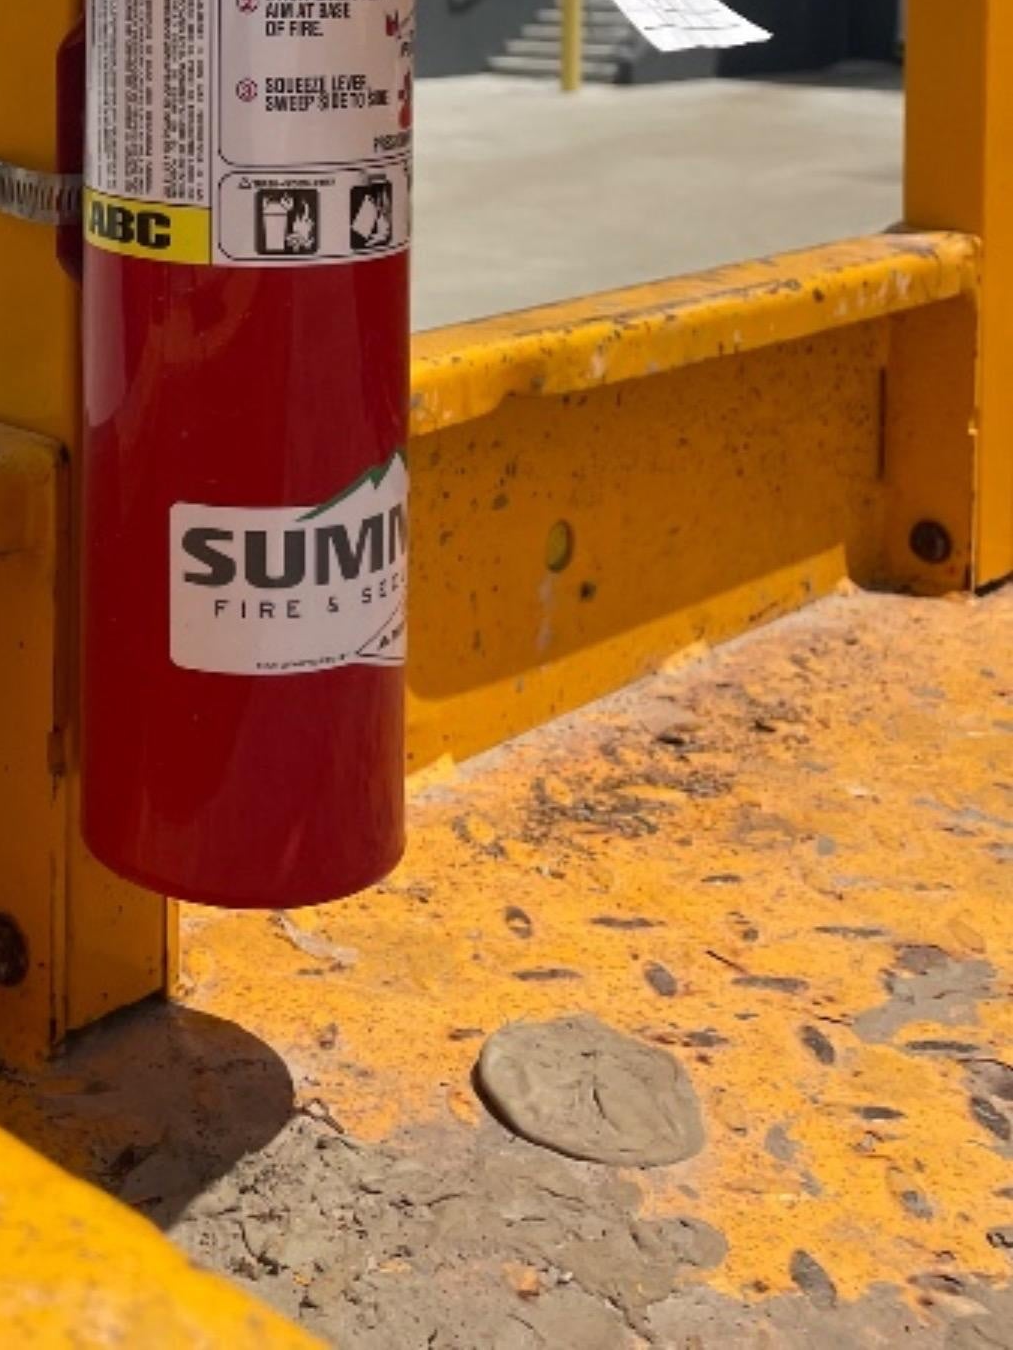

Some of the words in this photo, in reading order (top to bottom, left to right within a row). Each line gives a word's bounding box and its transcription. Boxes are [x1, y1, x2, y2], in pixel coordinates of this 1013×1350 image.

[265, 3, 294, 19] AIM
[296, 3, 315, 19] AT
[319, 3, 351, 19] BASE
[265, 21, 286, 37] OF
[289, 21, 324, 37] FIRE.
[265, 76, 326, 94] SQUEEZE
[265, 96, 315, 112] SWEEP
[318, 94, 348, 111] SIDE
[350, 93, 365, 109] TO
[89, 201, 172, 250] ABC
[214, 600, 301, 619] FIRE
